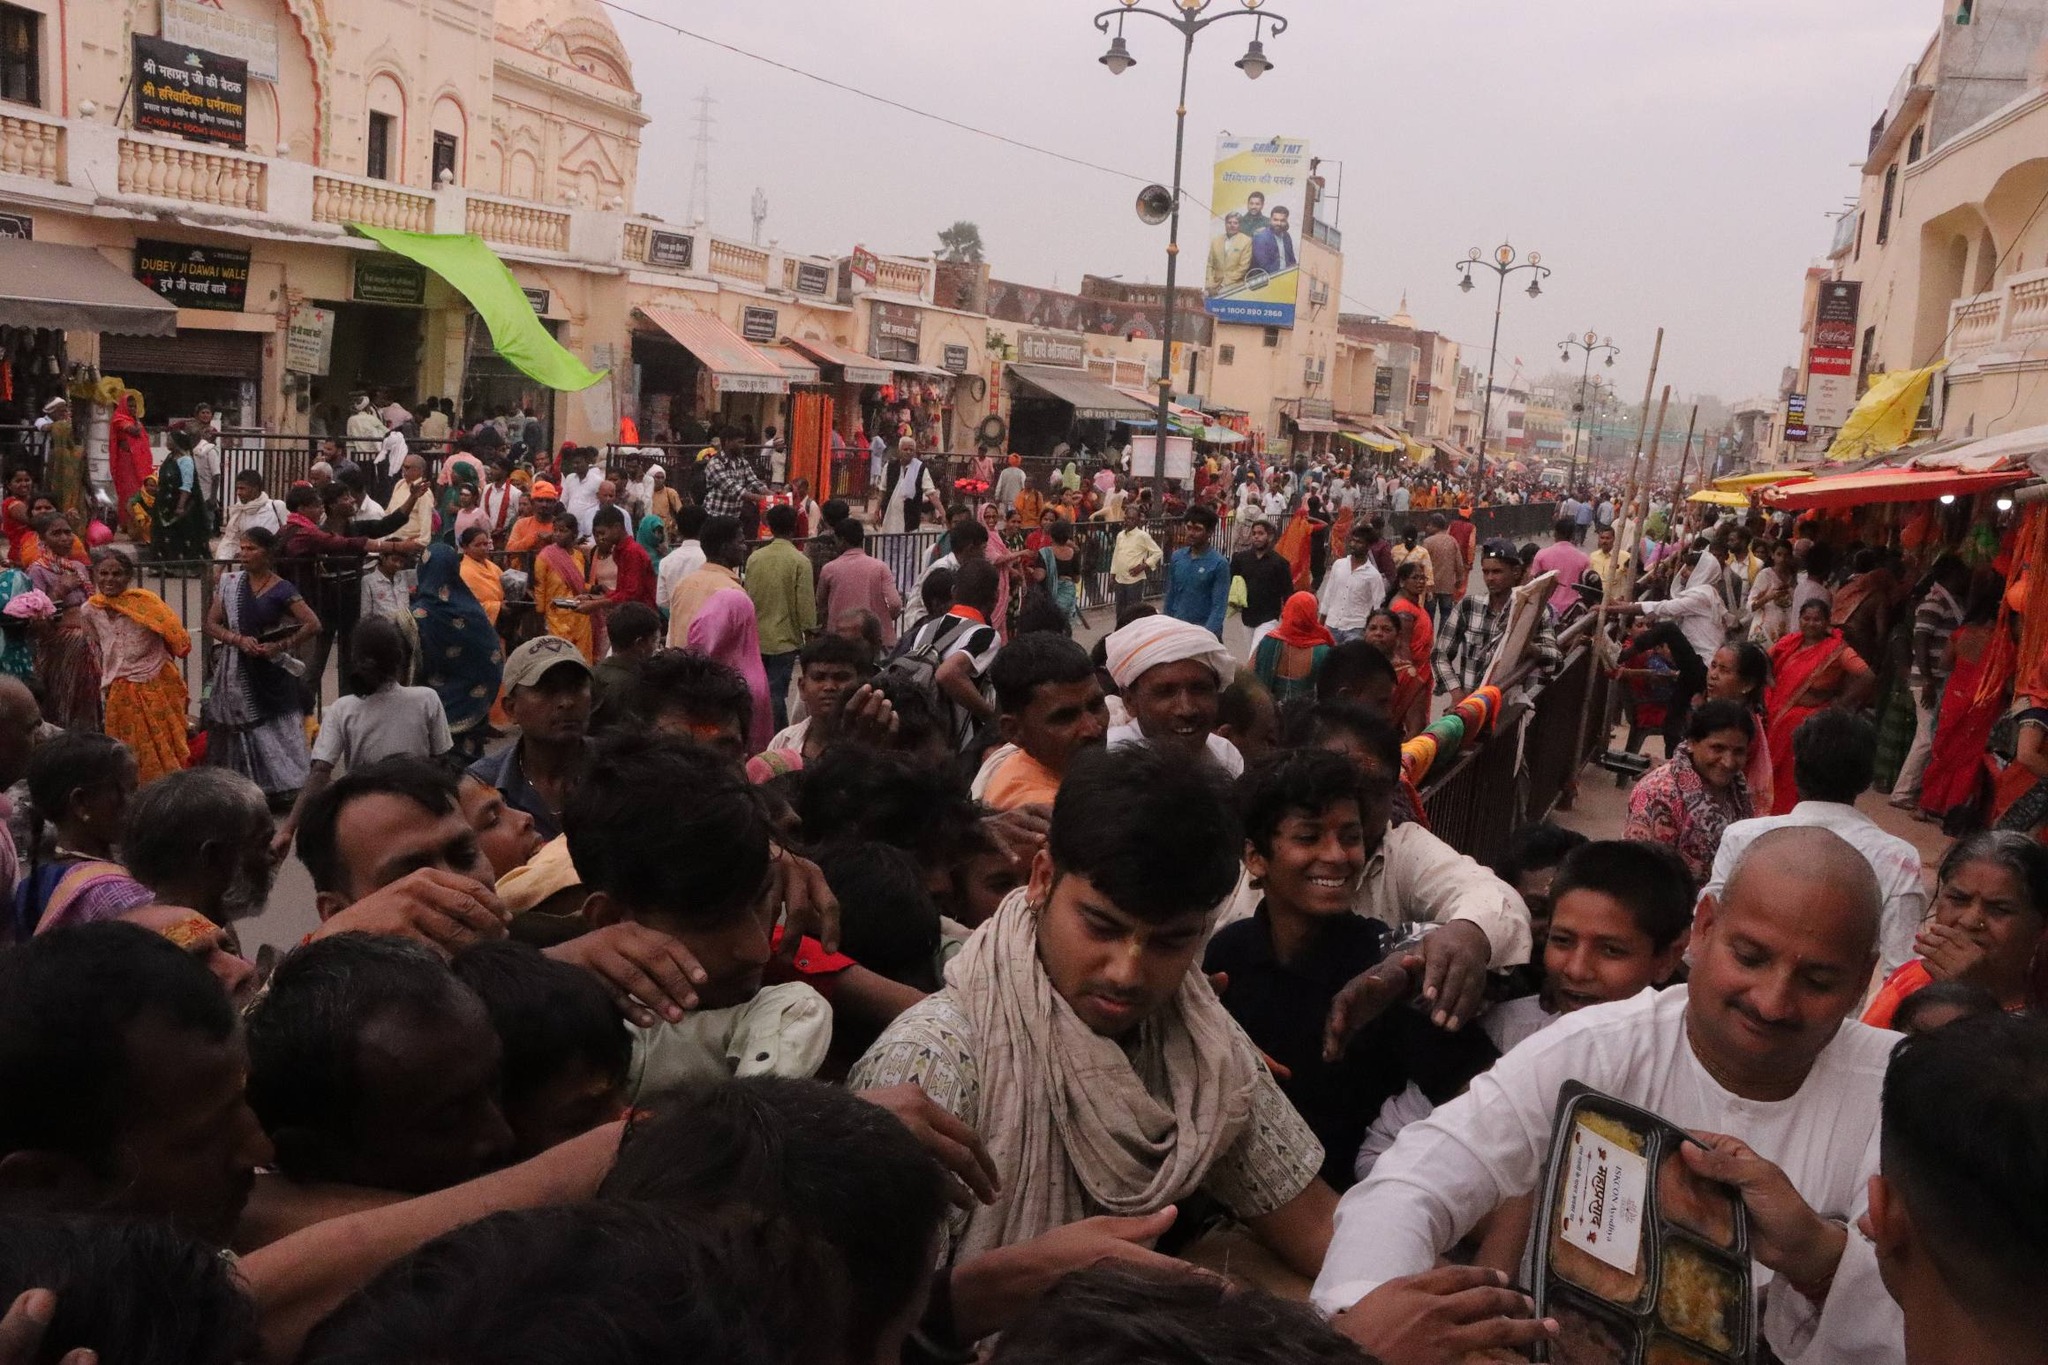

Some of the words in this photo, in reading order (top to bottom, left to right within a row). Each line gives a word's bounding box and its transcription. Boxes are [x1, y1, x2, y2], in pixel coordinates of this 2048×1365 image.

[143, 59, 156, 75] श्री
[159, 64, 189, 87] महाप्रभु
[192, 70, 204, 86] जी
[206, 73, 218, 89] की
[221, 76, 242, 93] बैठक
[142, 81, 155, 98] श्री
[158, 86, 203, 107] हरिवाटिका
[206, 96, 242, 115] धर्मशाला
[1283, 144, 1303, 154] TMT
[141, 258, 177, 271] DUBEY
[179, 263, 187, 274] JI
[189, 263, 219, 277] DAWAI
[221, 267, 247, 280] WALE
[160, 276, 173, 292] दुबे
[176, 277, 187, 290] जी
[189, 280, 209, 294] दवाई
[211, 281, 227, 294] वाले
[1023, 336, 1033, 358] श्री
[1034, 337, 1047, 358] राधे
[1047, 338, 1082, 361] भोजनालय
[1589, 1165, 1608, 1229] महाप्रसाद
[1611, 1165, 1622, 1202] ISKCON
[1606, 1202, 1617, 1242] Ayodhya
